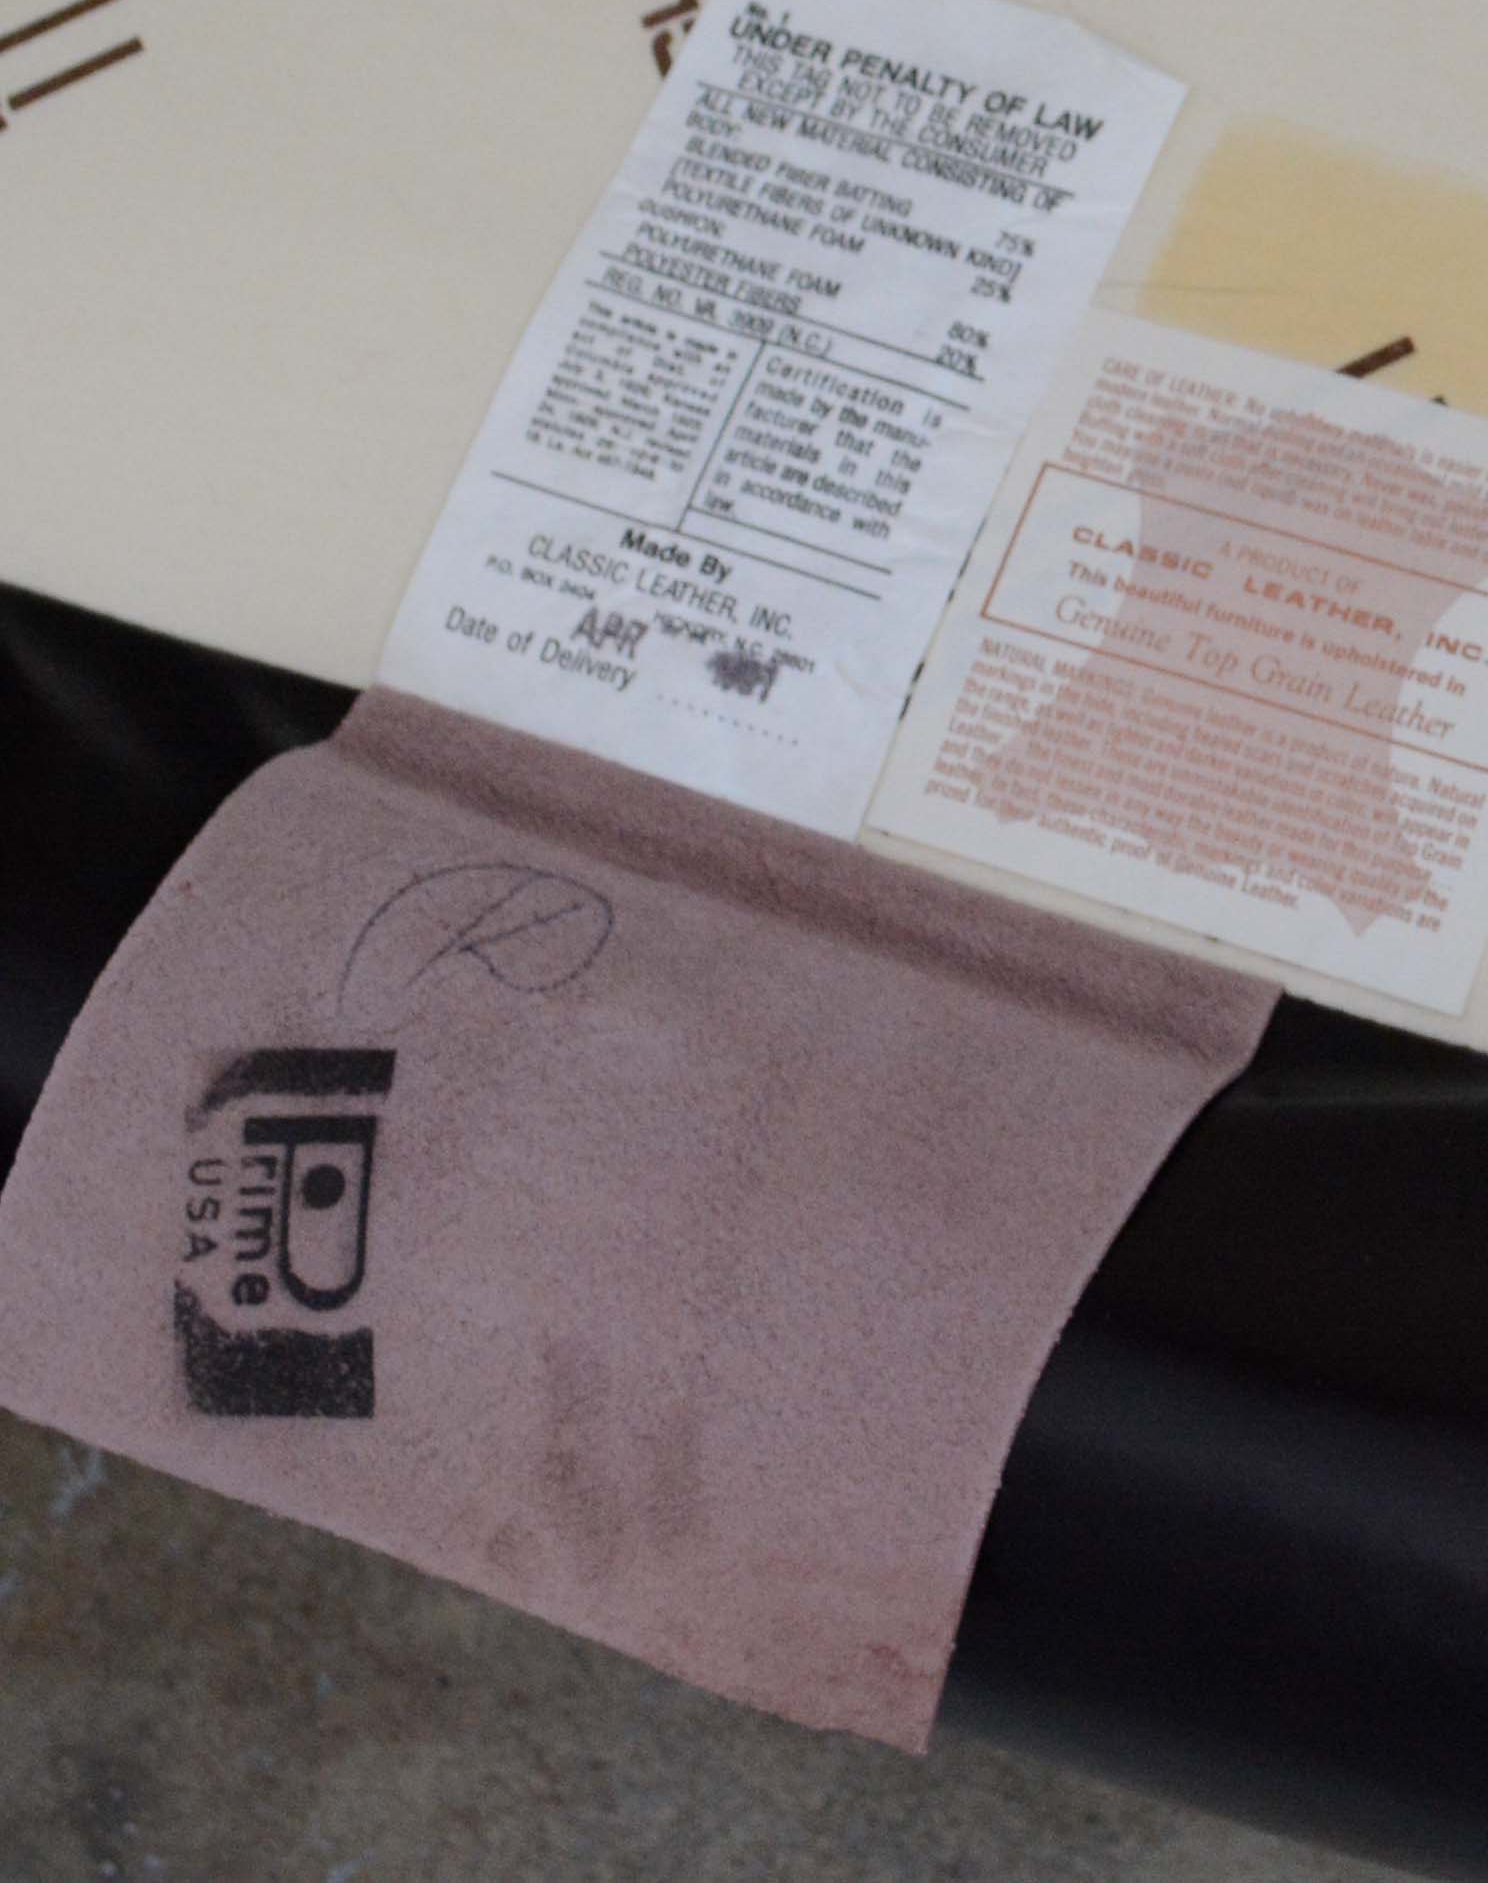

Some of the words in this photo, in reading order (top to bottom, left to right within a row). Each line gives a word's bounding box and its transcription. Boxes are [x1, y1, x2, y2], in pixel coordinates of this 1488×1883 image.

[726, 15, 834, 64] UNDER
[838, 48, 976, 105] PENALTY
[980, 88, 1028, 121] OF
[1031, 102, 1105, 143] LAW
[729, 41, 785, 75] THIS
[789, 59, 835, 90] TAG
[837, 74, 888, 105] NOT
[891, 89, 925, 117] TO
[927, 99, 959, 126] BE
[963, 110, 1080, 163] REMOVED
[693, 85, 737, 115] ALL
[740, 98, 794, 132] NEW
[795, 116, 895, 163] MATERIAL
[898, 147, 1030, 204] CONSISTING
[1032, 188, 1065, 214] OF
[736, 68, 826, 112] EXCEPT
[828, 96, 864, 123] BY
[866, 107, 914, 138] THE
[915, 122, 1050, 179] CONSUMER
[683, 133, 772, 175] BLENDED
[773, 161, 833, 193] FIBER
[832, 178, 916, 218] BATTING
[994, 230, 1039, 258] 75%
[757, 182, 827, 217] FIBERS
[828, 203, 859, 226] OF
[858, 213, 963, 260] UNKNOWN
[634, 220, 784, 280] POLYURETHANE
[784, 267, 845, 300] FOAM
[658, 175, 807, 236] POLYURETHANE
[807, 222, 868, 255] FOAM
[969, 276, 1016, 304] 25%
[619, 242, 734, 292] POLYESTER
[732, 278, 804, 315] FIBERS
[933, 344, 982, 375] 20%
[754, 379, 806, 408] made
[807, 397, 834, 422] by
[836, 405, 870, 429] the
[763, 354, 907, 417] Certification
[921, 408, 945, 429] is
[732, 420, 823, 464] materials
[835, 456, 859, 477] in
[872, 468, 913, 495] this
[742, 398, 818, 438] facturer
[832, 428, 876, 457] that
[888, 448, 924, 473] the
[712, 469, 732, 487] in
[738, 474, 845, 524] accordance
[849, 513, 893, 540] with
[722, 444, 779, 477] article
[778, 464, 811, 487] are
[809, 471, 904, 518] described
[518, 565, 555, 588] BOX
[523, 531, 632, 586] CLASSIC
[631, 566, 746, 624] LEATHER,
[745, 603, 800, 641] INC.
[617, 527, 695, 569] Made
[695, 553, 736, 586] By
[1068, 522, 1216, 582] CLASSIC
[1239, 573, 1408, 641] LEATHER,
[1233, 545, 1332, 589] PRODUCT
[1334, 574, 1364, 597] OF
[440, 604, 504, 646] Date
[502, 624, 536, 656] of
[535, 635, 640, 694] Delivery
[568, 602, 651, 660] APR
[1047, 590, 1178, 656] Genuine
[1176, 629, 1246, 682] Top
[1244, 649, 1340, 705] Grain
[1341, 679, 1461, 743] Leather
[1064, 558, 1112, 588] This
[1110, 572, 1205, 616] beautiful
[1202, 600, 1298, 644] furniture
[1297, 630, 1317, 649] is
[1318, 635, 1445, 692] upholstered
[1443, 674, 1470, 697] in
[1424, 776, 1488, 811] Natural
[1035, 810, 1110, 849] authentic
[1107, 834, 1154, 866] proof
[1171, 853, 1241, 891] Genuine
[181, 1157, 218, 1265] USA
